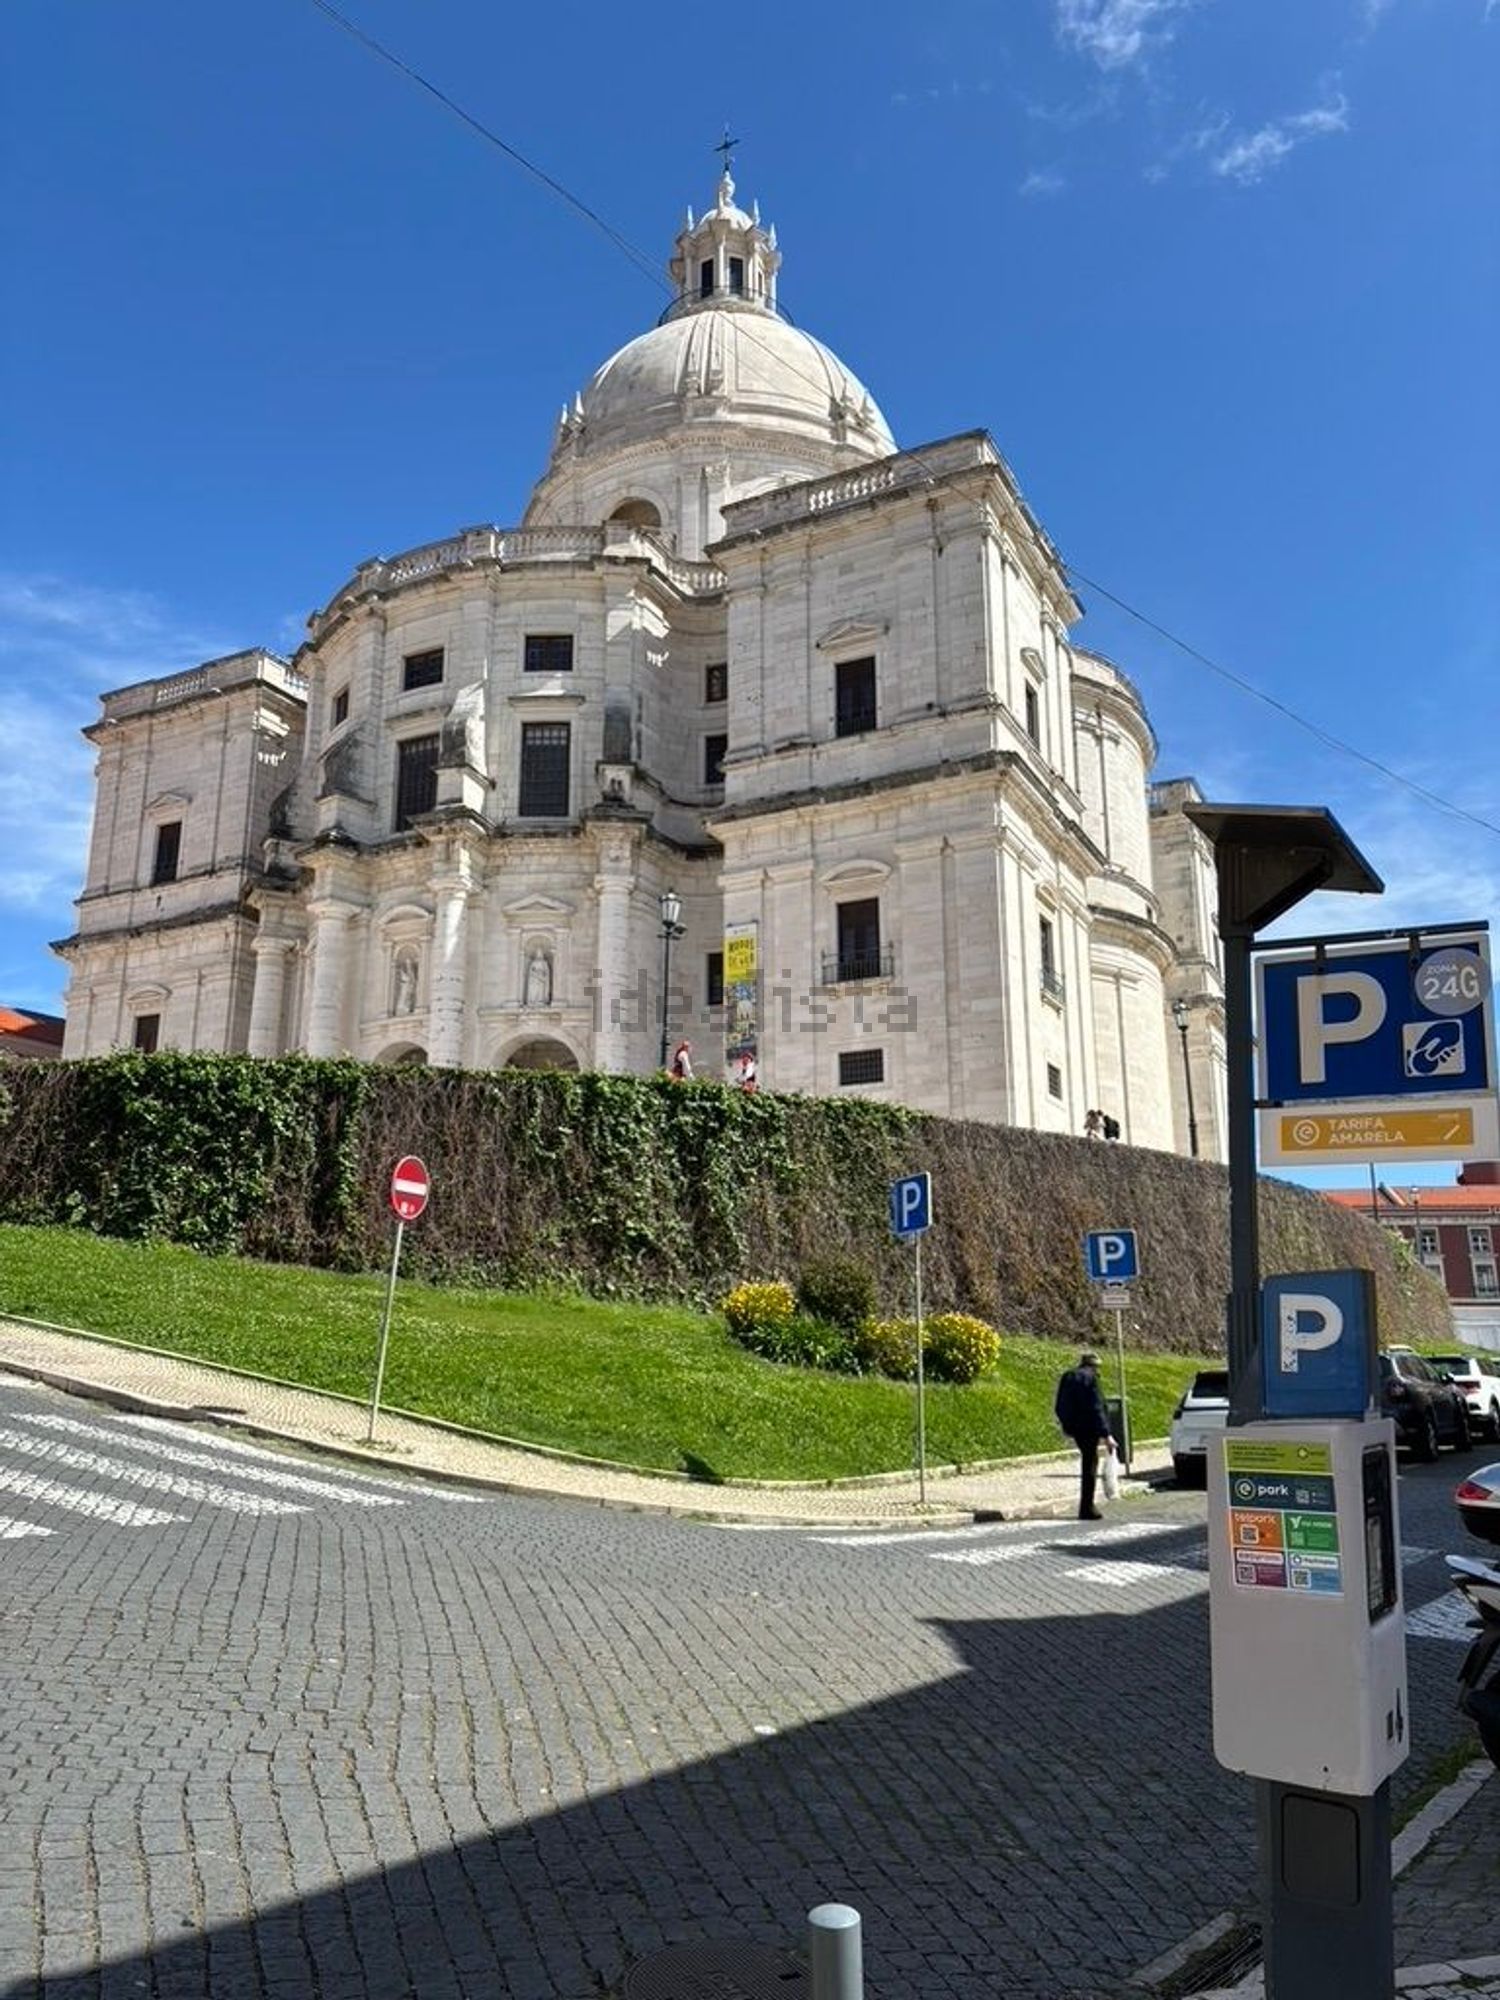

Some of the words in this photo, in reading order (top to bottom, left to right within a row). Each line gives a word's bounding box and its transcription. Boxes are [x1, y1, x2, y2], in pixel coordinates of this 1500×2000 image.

[1297, 971, 1387, 1085] P
[1328, 1117, 1386, 1131] TARIFA
[1328, 1130, 1407, 1144] AMARELA
[902, 1181, 921, 1227] P
[1100, 1236, 1126, 1274] P
[1279, 1292, 1344, 1373] P
[1257, 1484, 1289, 1496] park
